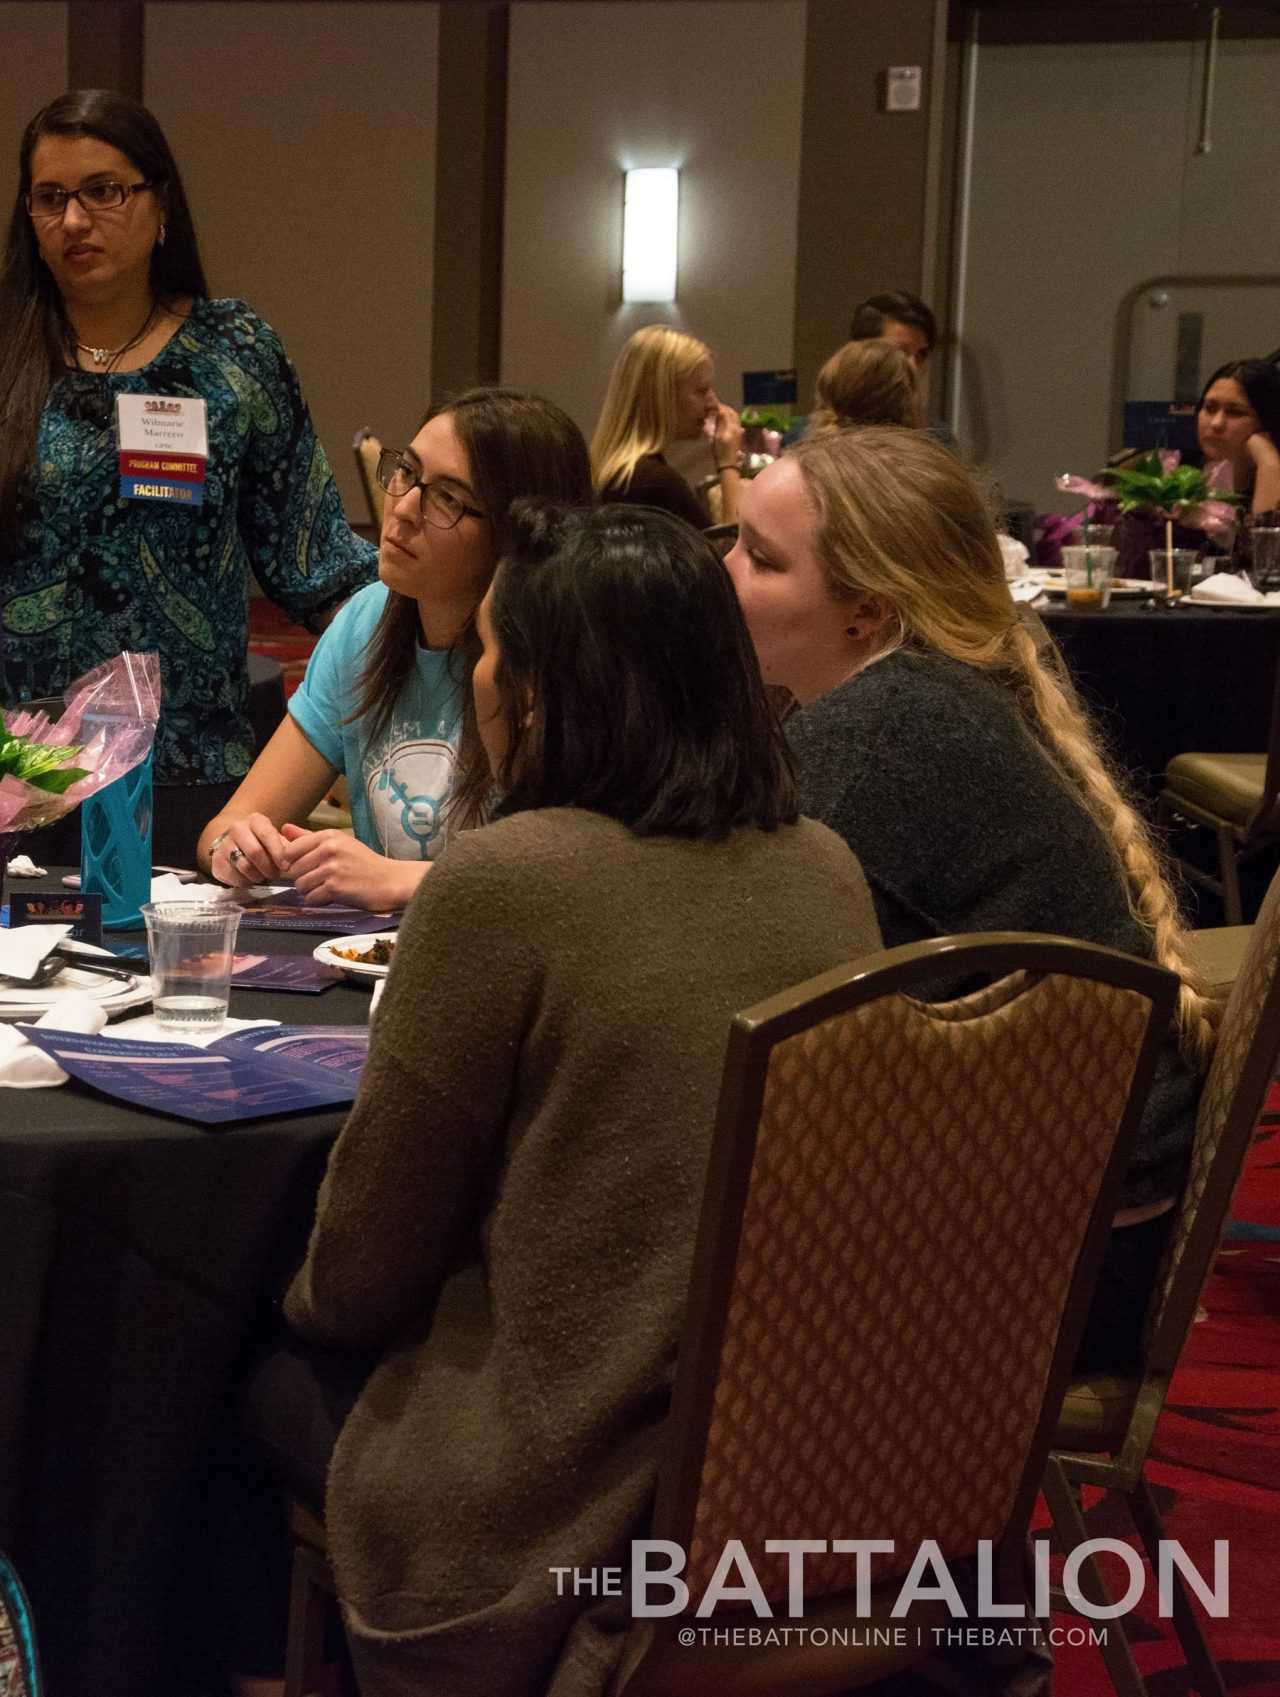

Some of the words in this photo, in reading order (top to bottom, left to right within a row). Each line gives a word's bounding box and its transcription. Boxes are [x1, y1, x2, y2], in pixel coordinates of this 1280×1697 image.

[128, 459, 160, 470] PROGRAM
[161, 461, 198, 473] COMMITTEE
[133, 484, 192, 499] FACILITATOR
